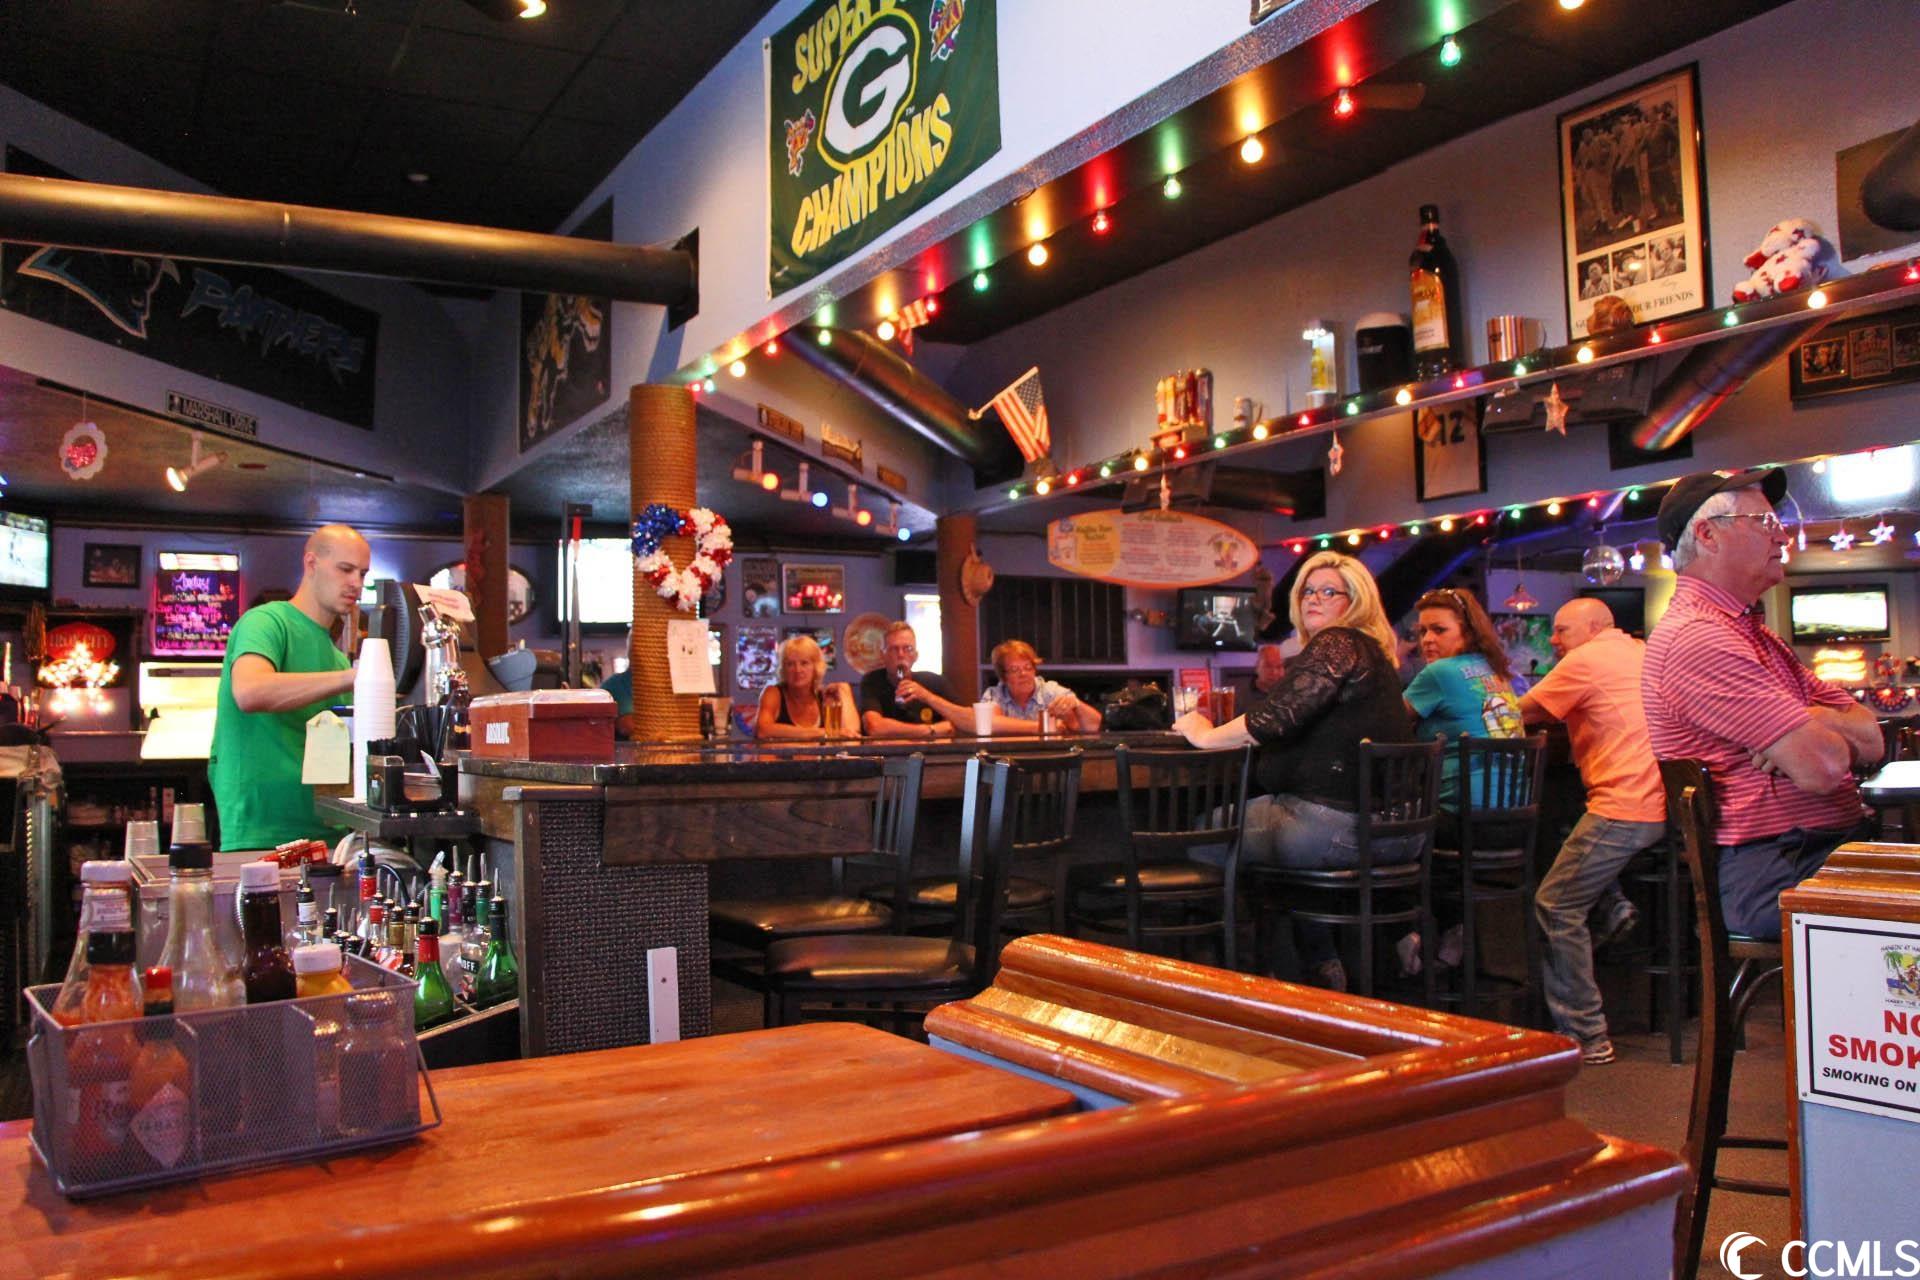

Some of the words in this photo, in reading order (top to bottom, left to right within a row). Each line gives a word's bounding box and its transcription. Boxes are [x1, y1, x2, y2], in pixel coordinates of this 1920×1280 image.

[791, 93, 952, 258] CHAMPIONS
[1653, 290, 1694, 309] FRIENDS
[180, 268, 365, 384] PANTHERS
[183, 399, 229, 426] MARSHALL
[230, 412, 256, 436] DRIVE
[1828, 1034, 1920, 1070] SMOK
[1822, 1066, 1889, 1088] SMOKING
[1895, 1079, 1917, 1093] ON
